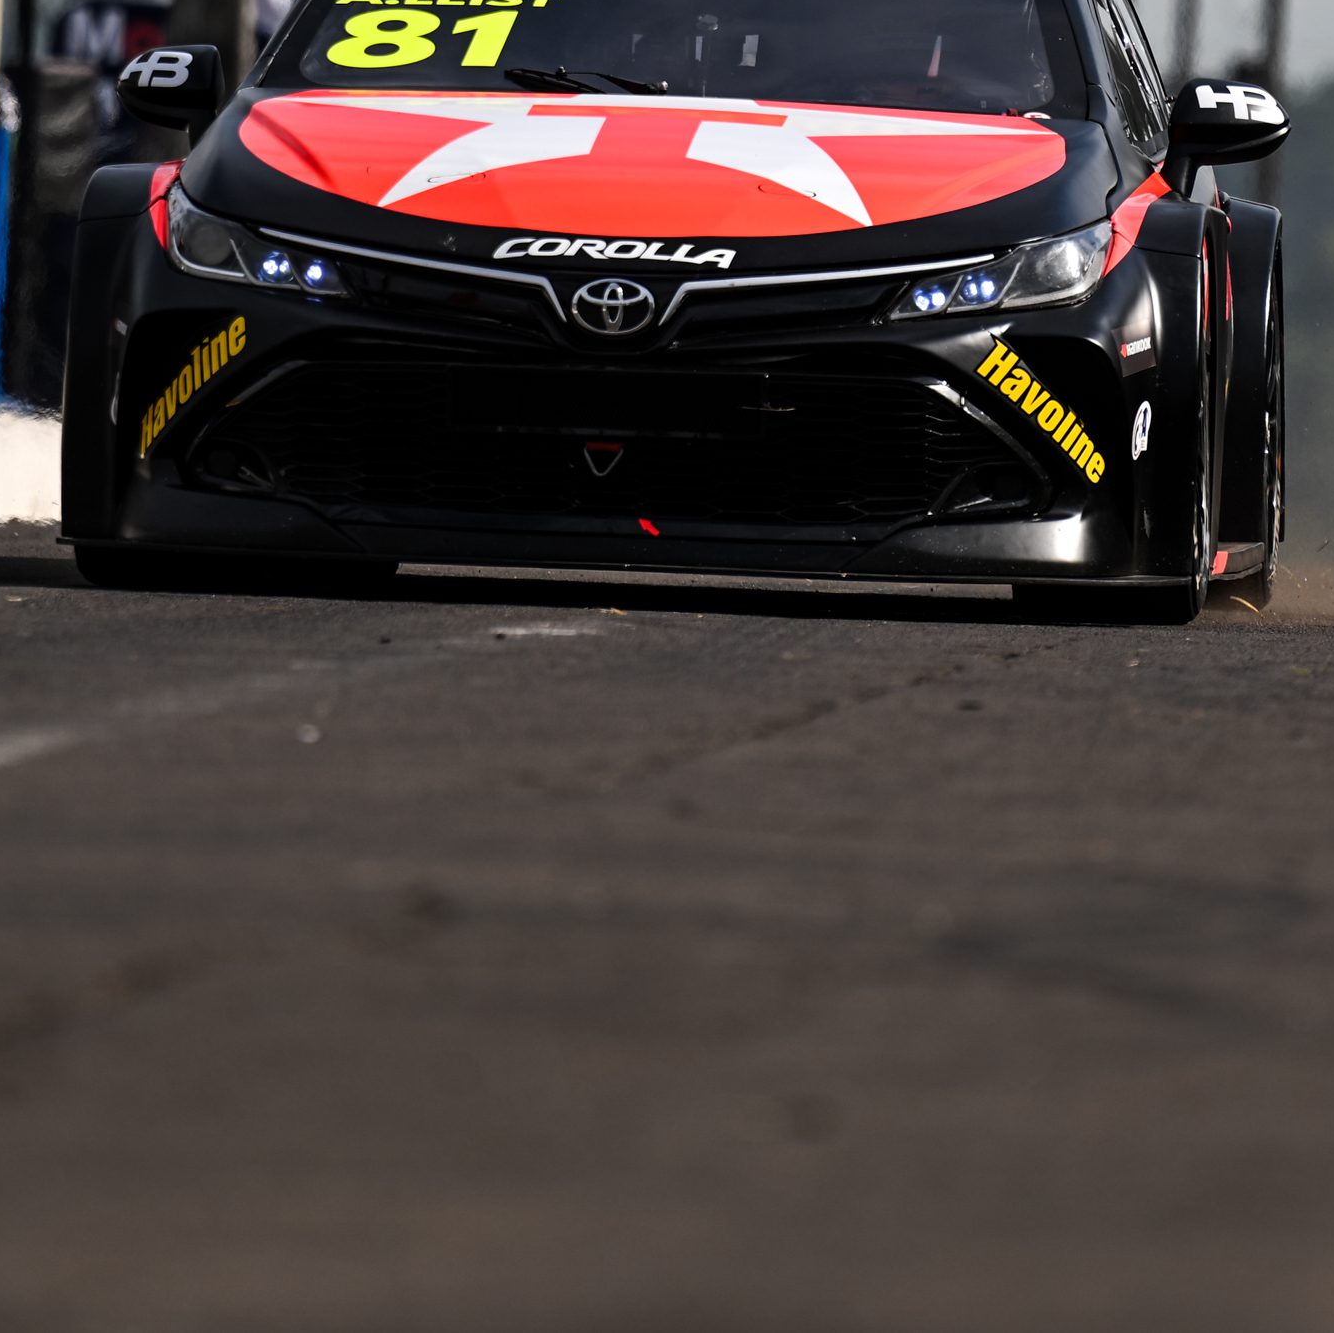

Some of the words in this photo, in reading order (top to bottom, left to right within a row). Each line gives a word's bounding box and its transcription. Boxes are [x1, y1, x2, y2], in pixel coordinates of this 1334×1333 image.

[326, 8, 519, 68] 81
[493, 238, 736, 269] COROLLA
[140, 316, 247, 459] Havoline
[976, 338, 1106, 484] Havoline
